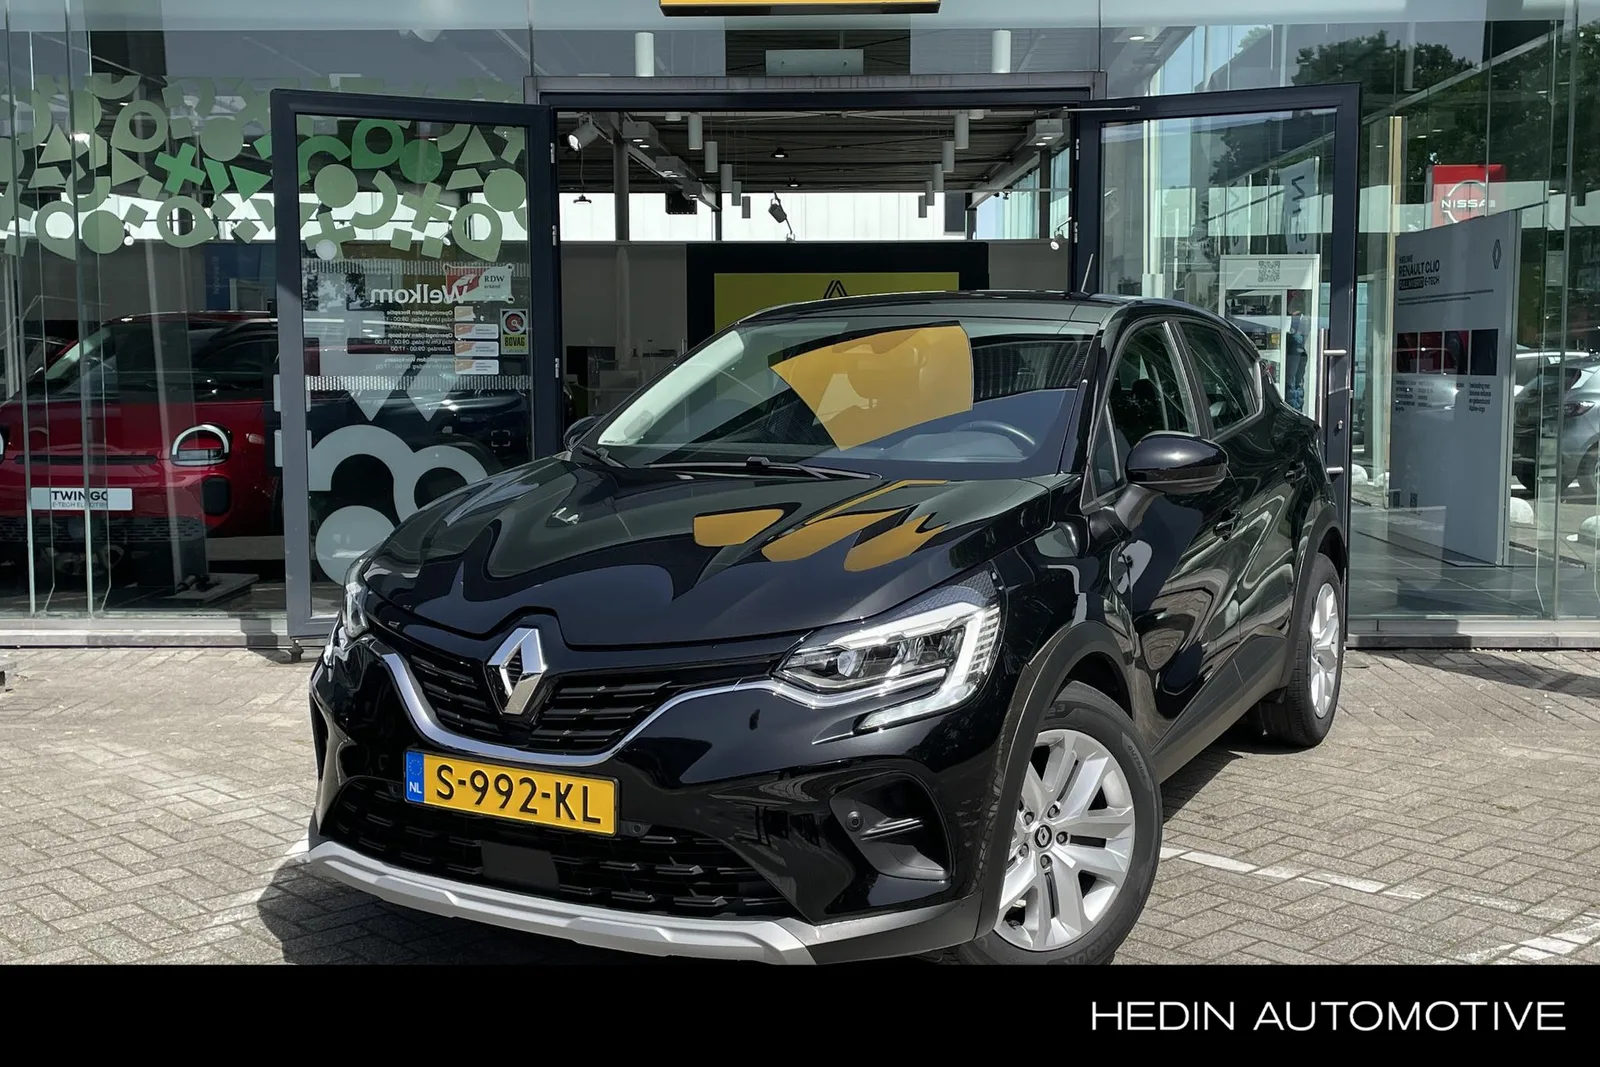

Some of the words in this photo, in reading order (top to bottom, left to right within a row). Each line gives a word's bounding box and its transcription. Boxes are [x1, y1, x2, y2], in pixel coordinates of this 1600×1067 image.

[1398, 262, 1425, 277] RENAULT
[1425, 259, 1440, 273] CLIO
[484, 275, 505, 283] RDW
[504, 336, 526, 347] BOVAG
[409, 781, 422, 794] NL
[436, 764, 602, 825] S-992-KL
